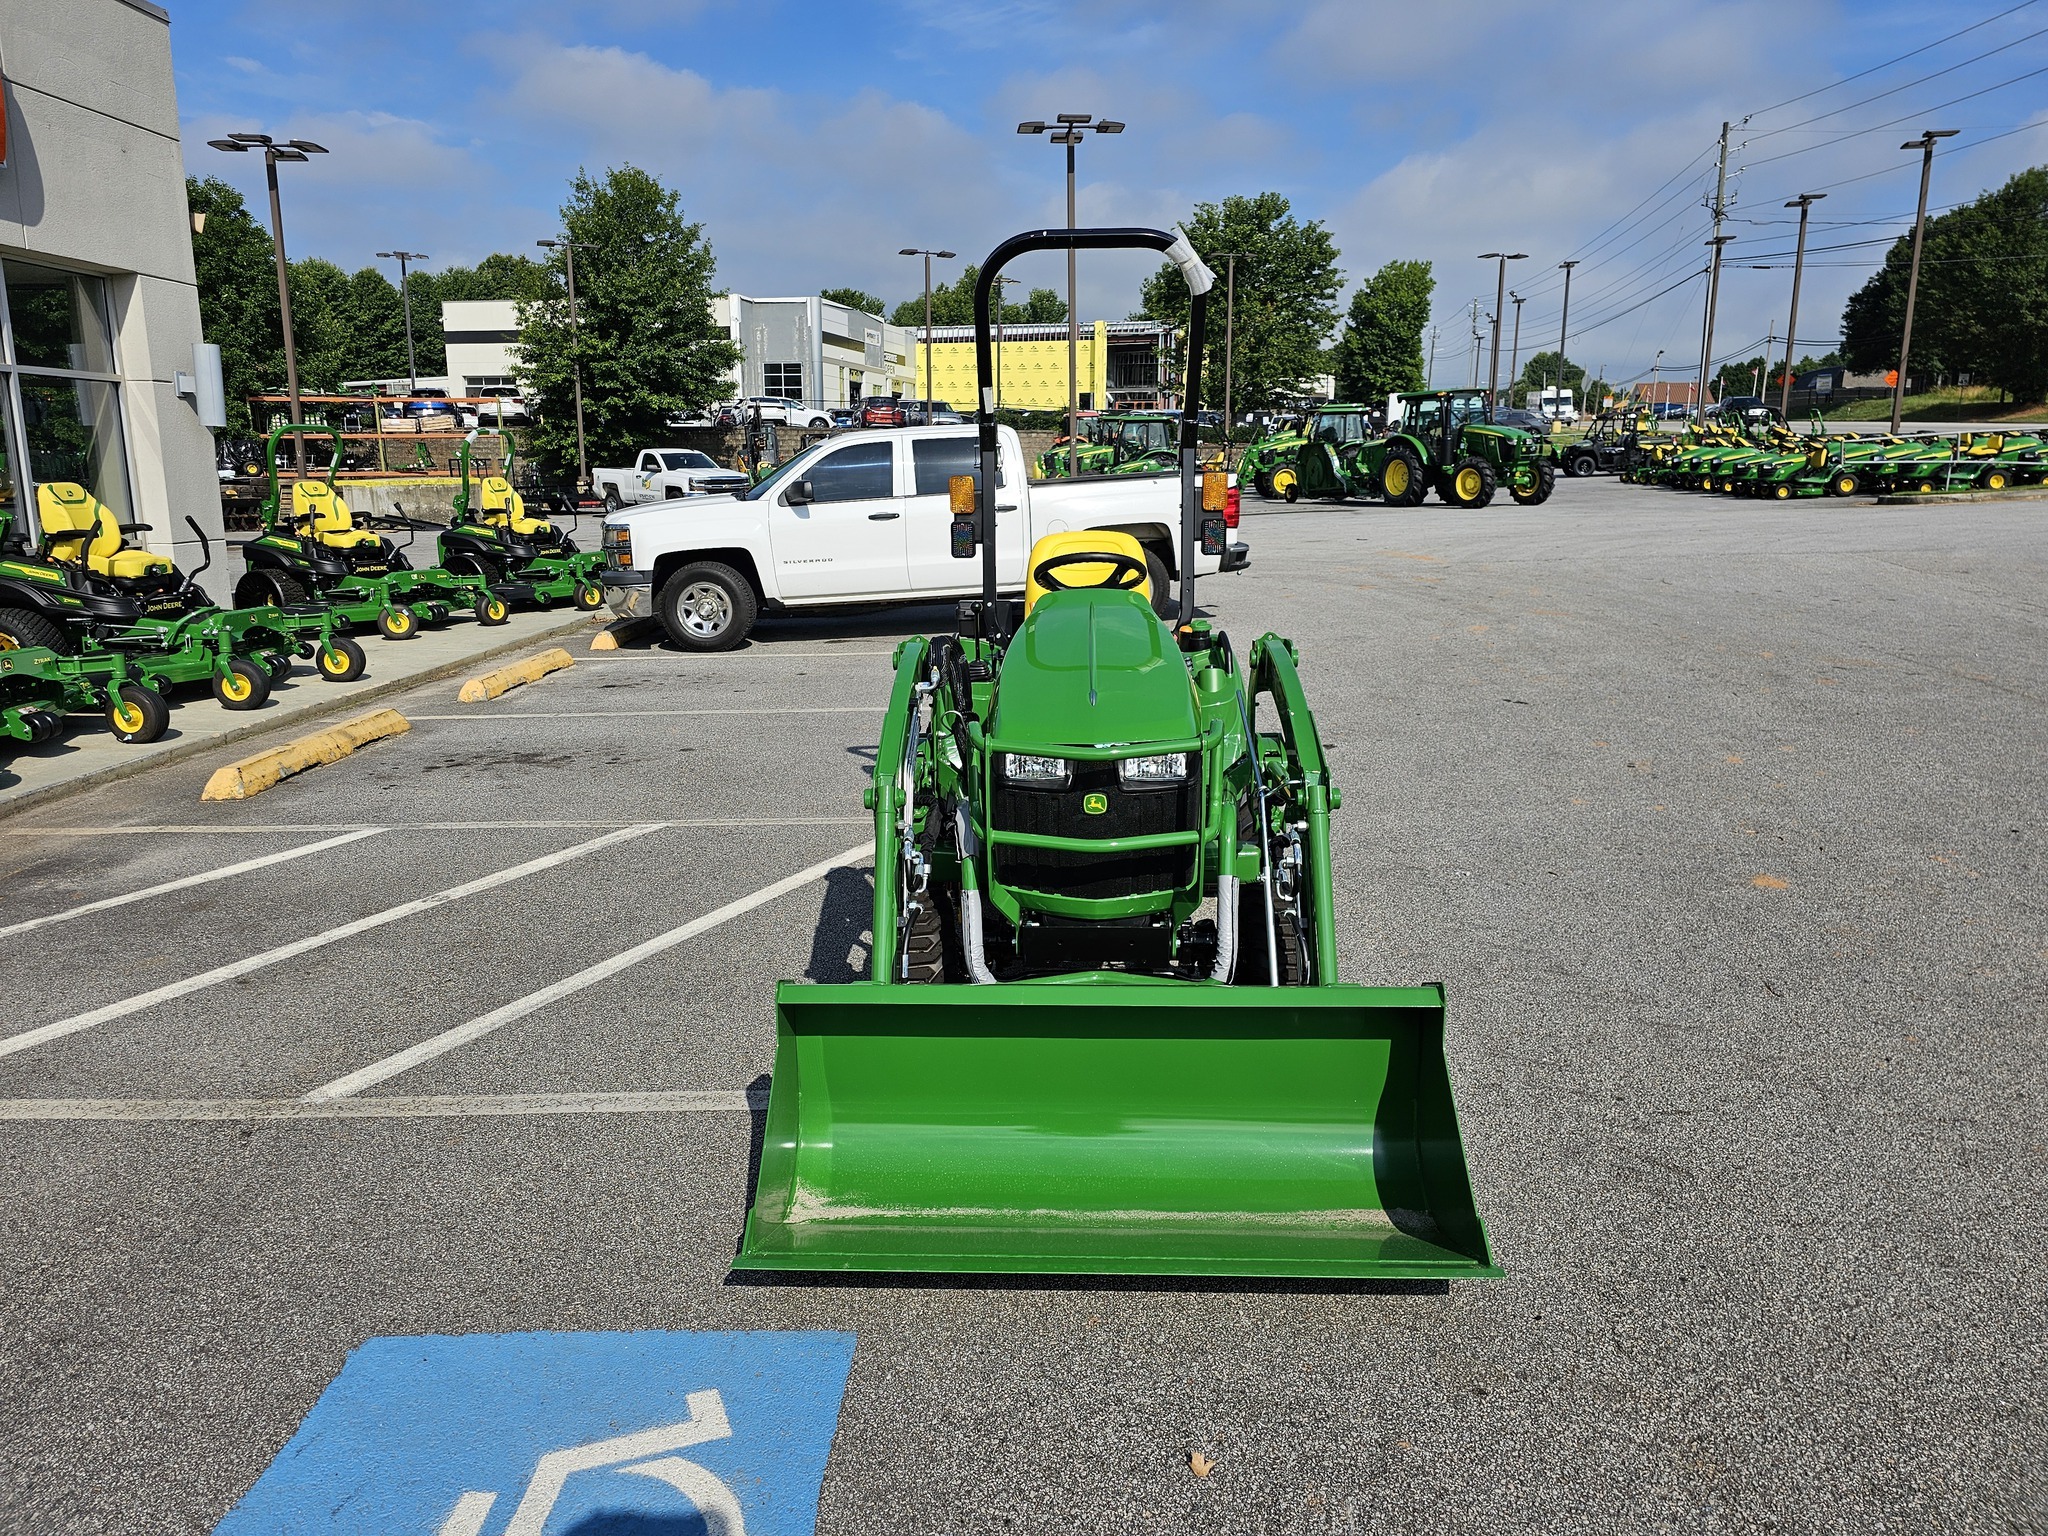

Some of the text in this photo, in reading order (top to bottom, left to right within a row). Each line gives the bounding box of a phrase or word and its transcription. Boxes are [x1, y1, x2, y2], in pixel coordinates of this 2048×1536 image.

[783, 557, 833, 565] SILVERADO
[146, 601, 183, 613] JOHN DEERE
